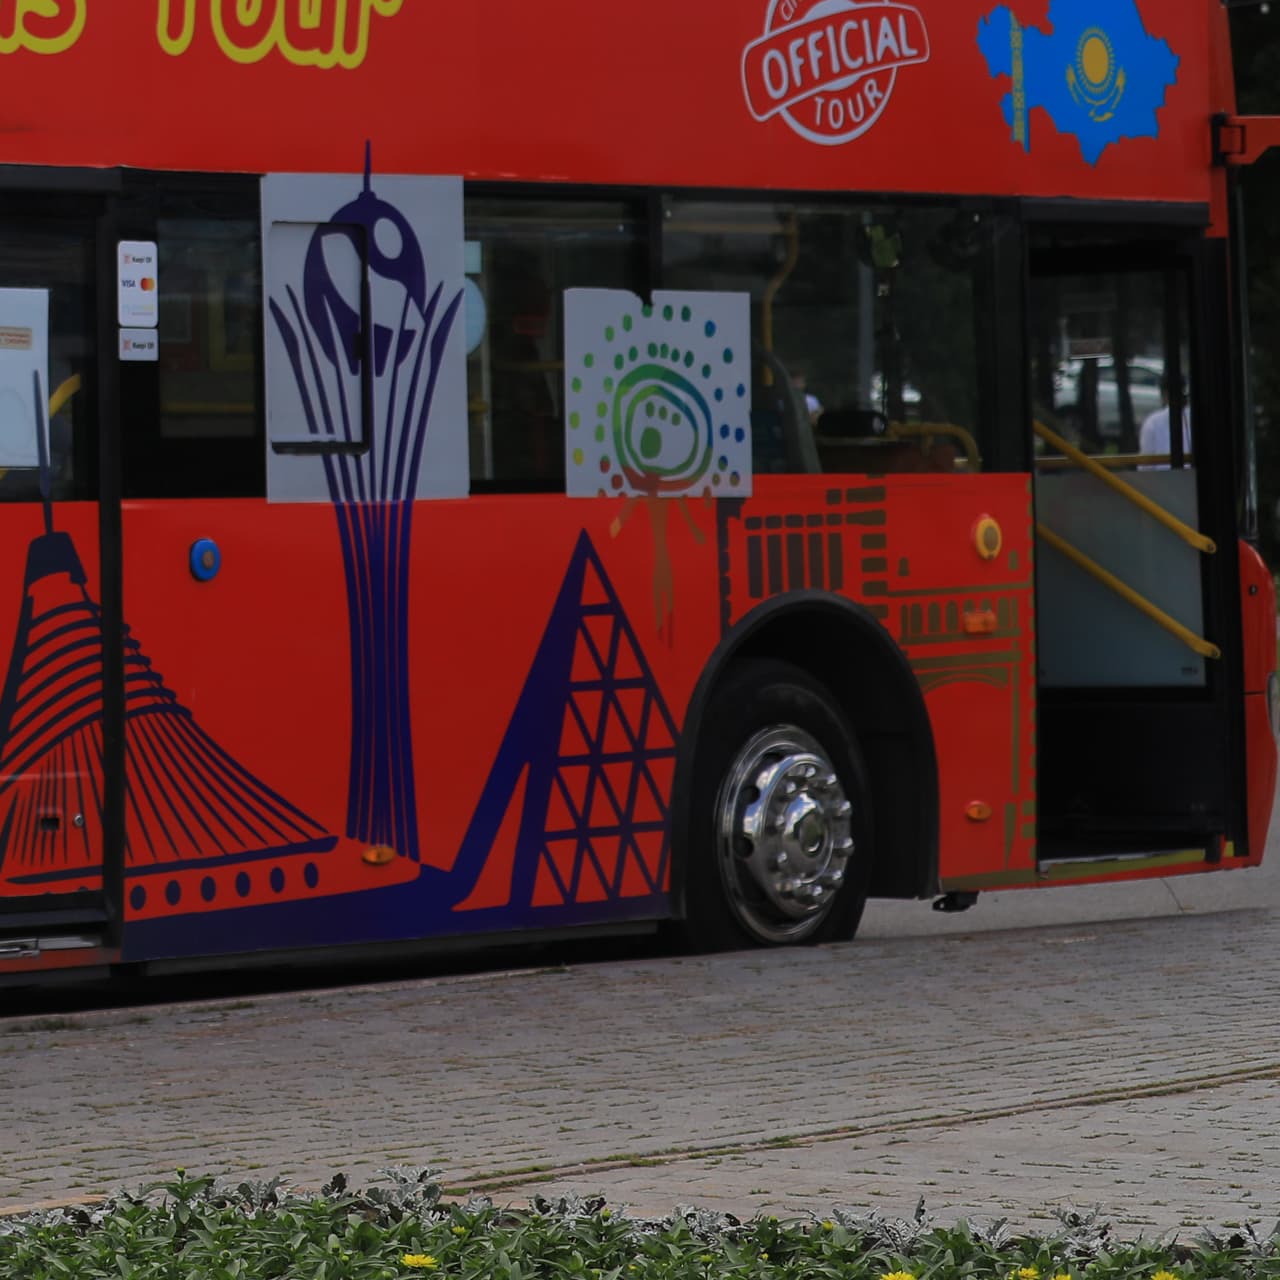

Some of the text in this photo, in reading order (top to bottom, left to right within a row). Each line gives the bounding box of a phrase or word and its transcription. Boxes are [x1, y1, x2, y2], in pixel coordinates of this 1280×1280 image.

[761, 15, 919, 100] OFFICIAL
[815, 77, 883, 130] TOUR
[122, 279, 136, 288] VISA
